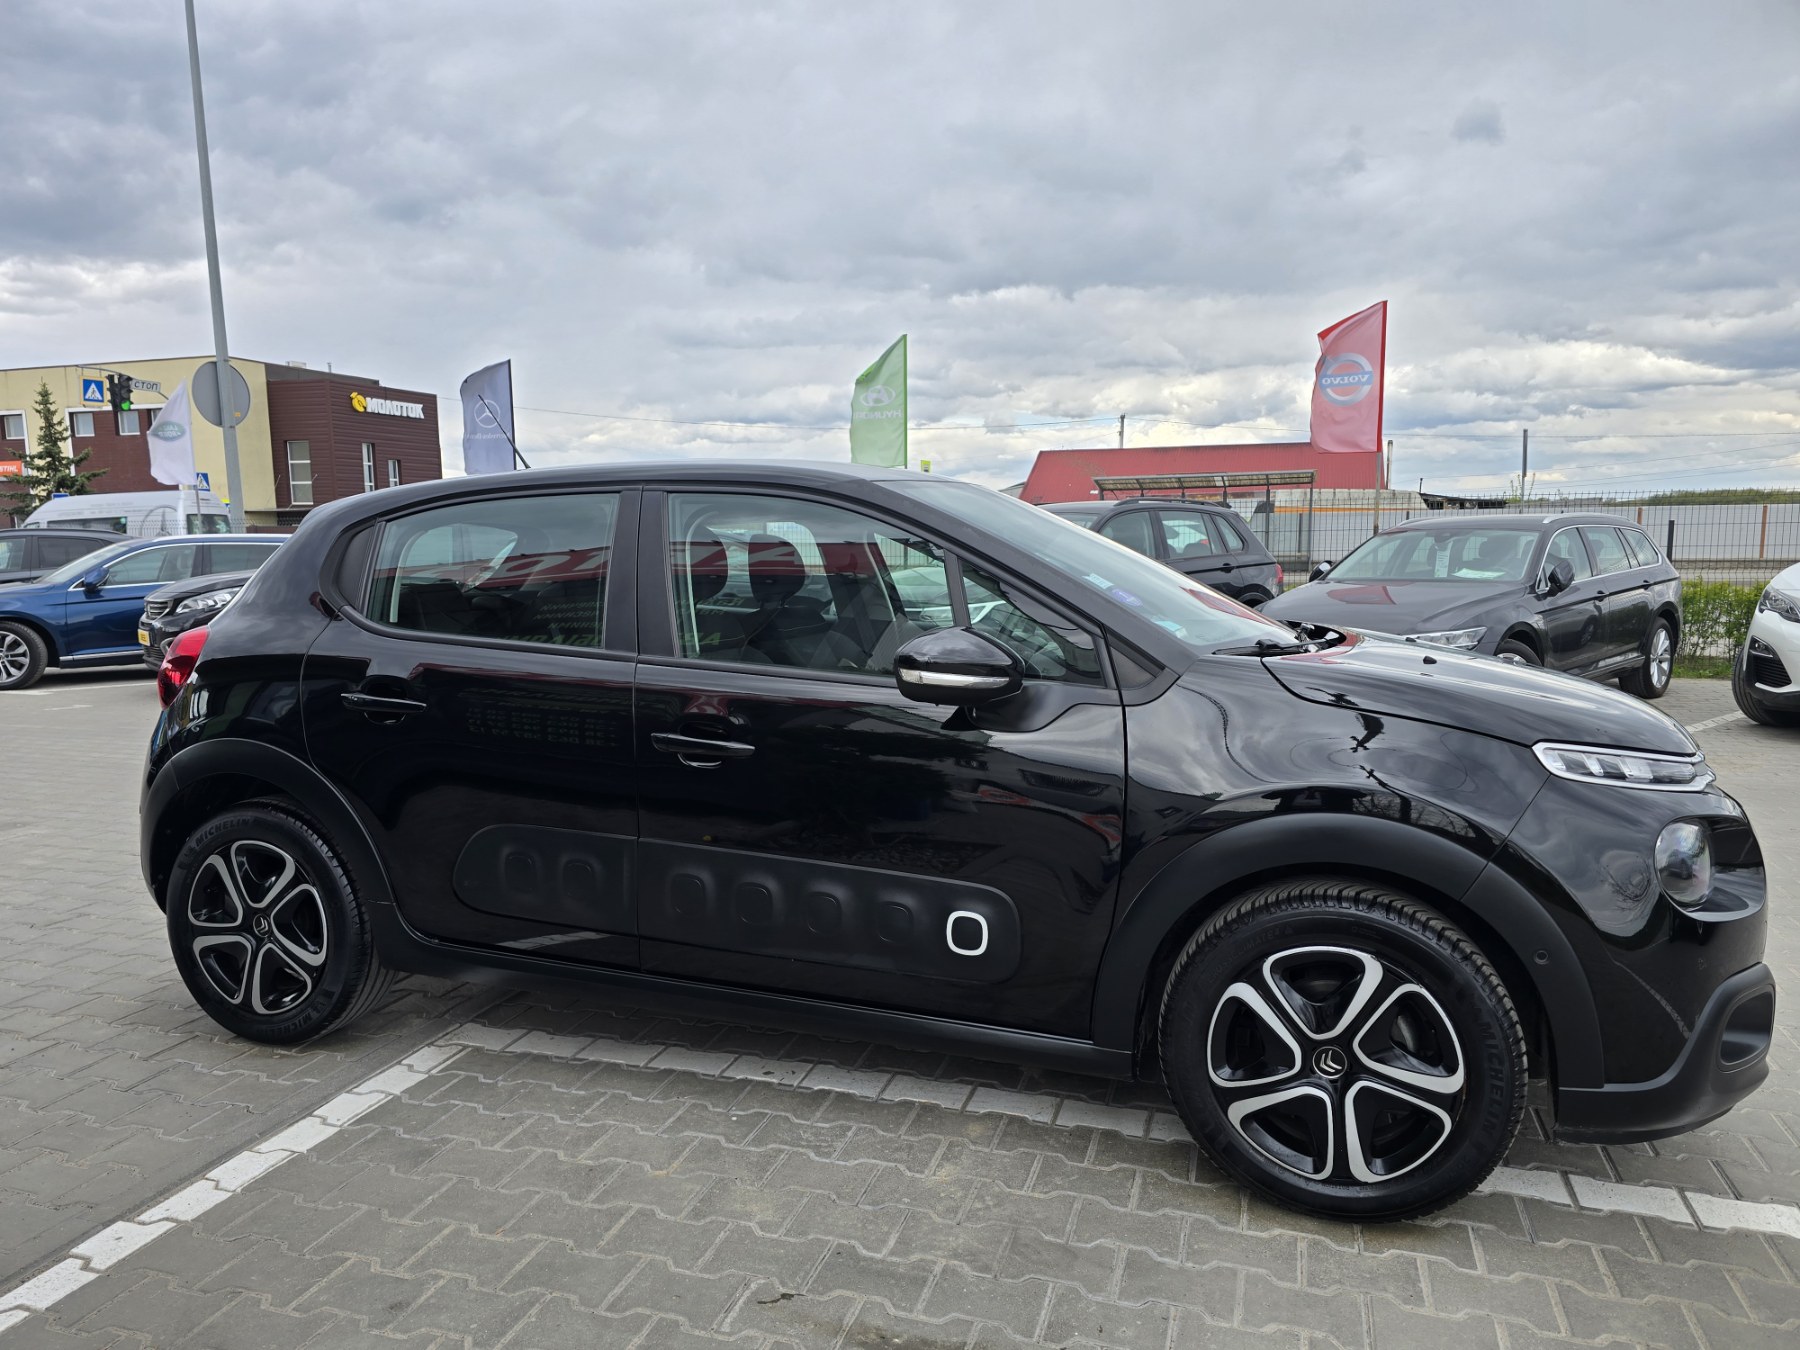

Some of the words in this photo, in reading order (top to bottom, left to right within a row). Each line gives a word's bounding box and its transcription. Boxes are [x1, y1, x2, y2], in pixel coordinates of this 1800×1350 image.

[134, 381, 158, 391] СТОП
[365, 397, 425, 419] МОЛОТОК
[194, 817, 250, 847] MICHELIN
[1479, 1020, 1506, 1140] MICHELIN
